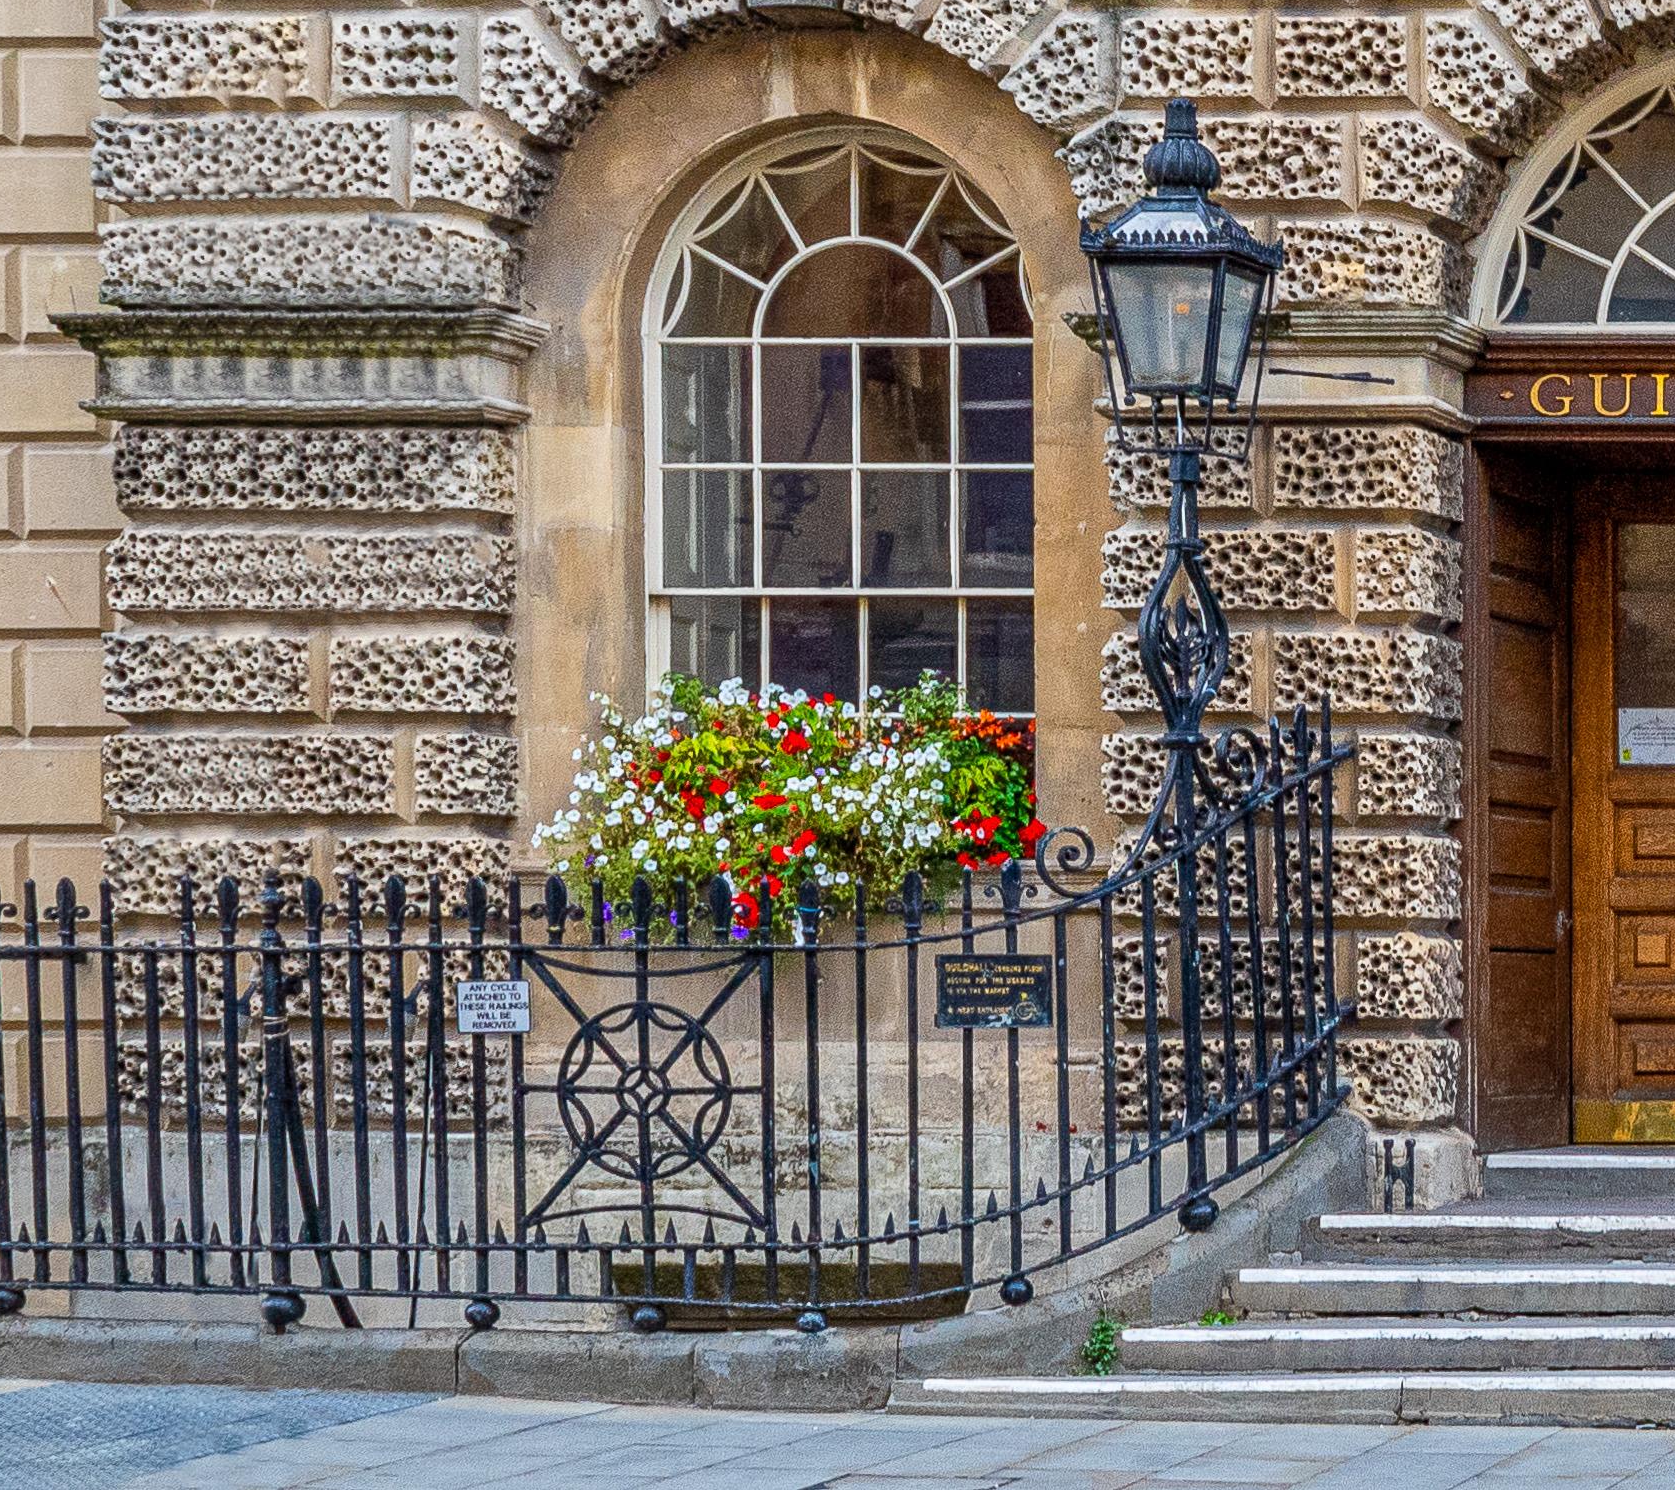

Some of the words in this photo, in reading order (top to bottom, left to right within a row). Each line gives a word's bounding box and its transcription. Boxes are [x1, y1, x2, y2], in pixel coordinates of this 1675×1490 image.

[469, 983, 487, 991] ANY
[491, 983, 517, 991] CYCLE
[464, 992, 506, 1000] ATTACHED
[509, 992, 521, 1000] TO
[460, 1002, 485, 1010] THESE
[488, 1002, 528, 1010] RAILINGS
